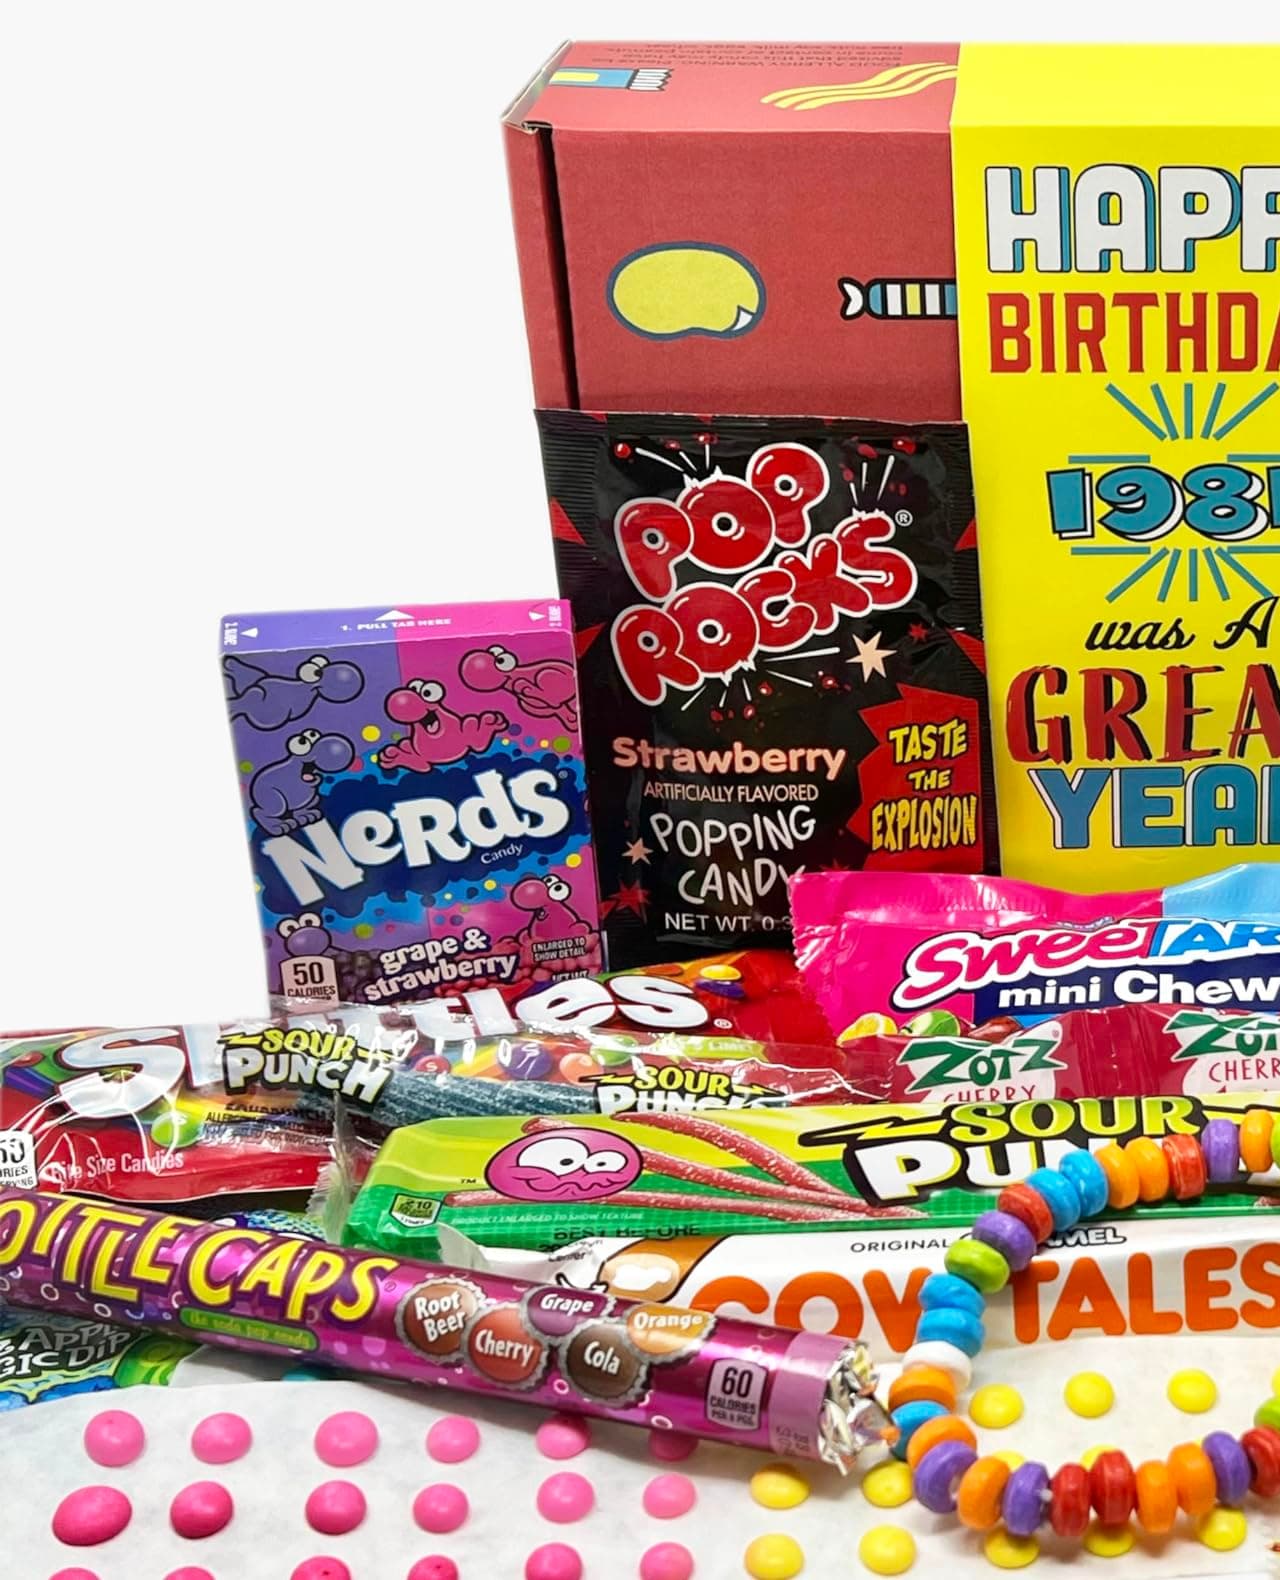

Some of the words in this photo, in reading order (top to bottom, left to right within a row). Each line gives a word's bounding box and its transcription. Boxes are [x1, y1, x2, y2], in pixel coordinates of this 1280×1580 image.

[614, 442, 830, 602] POP
[611, 508, 918, 706] ROCKS
[1085, 617, 1195, 651] was
[1213, 596, 1280, 649] A
[889, 717, 968, 765] TASTE
[613, 737, 846, 781] Strawberry
[644, 781, 733, 803] ARTIFICIALLY
[738, 783, 819, 802] FLAVORED
[908, 769, 951, 792] THE
[649, 804, 817, 862] POPPING
[871, 794, 977, 853] EXPLOSION
[480, 842, 523, 865] Candy
[665, 912, 709, 931] NET
[380, 938, 458, 975] grape
[462, 927, 487, 951] &
[533, 939, 573, 953] ENLARGED
[575, 937, 586, 947] TO
[534, 951, 557, 961] SHOW
[559, 948, 586, 958] DETAIL
[292, 962, 324, 986] 50
[363, 954, 517, 1002] strawberry
[287, 985, 336, 998] CALORIES
[998, 977, 1101, 1008] mini
[262, 1030, 356, 1060] SOUR
[225, 1048, 391, 1104] PUNCH
[634, 1066, 730, 1097] SOUR
[949, 1096, 1198, 1143] SOUR
[86, 1155, 116, 1178] Size
[121, 1150, 184, 1173] Candies
[451, 1215, 497, 1224] PRODUCT
[499, 1213, 551, 1223] ENLARGED
[552, 1213, 568, 1221] TO
[569, 1212, 599, 1221] SHOW
[554, 1225, 602, 1241] BEST
[614, 1223, 700, 1239] BEFORE
[850, 1237, 949, 1254] ORIGINAL
[415, 1293, 460, 1320] Root
[540, 1294, 594, 1315] Grape
[18, 1320, 118, 1352] APPL
[423, 1310, 466, 1343] Beer
[634, 1312, 703, 1331] Orange
[475, 1329, 535, 1367] Cherry
[583, 1341, 621, 1376] Cola
[721, 1366, 753, 1398] 60
[710, 1395, 756, 1415] CALORIES
